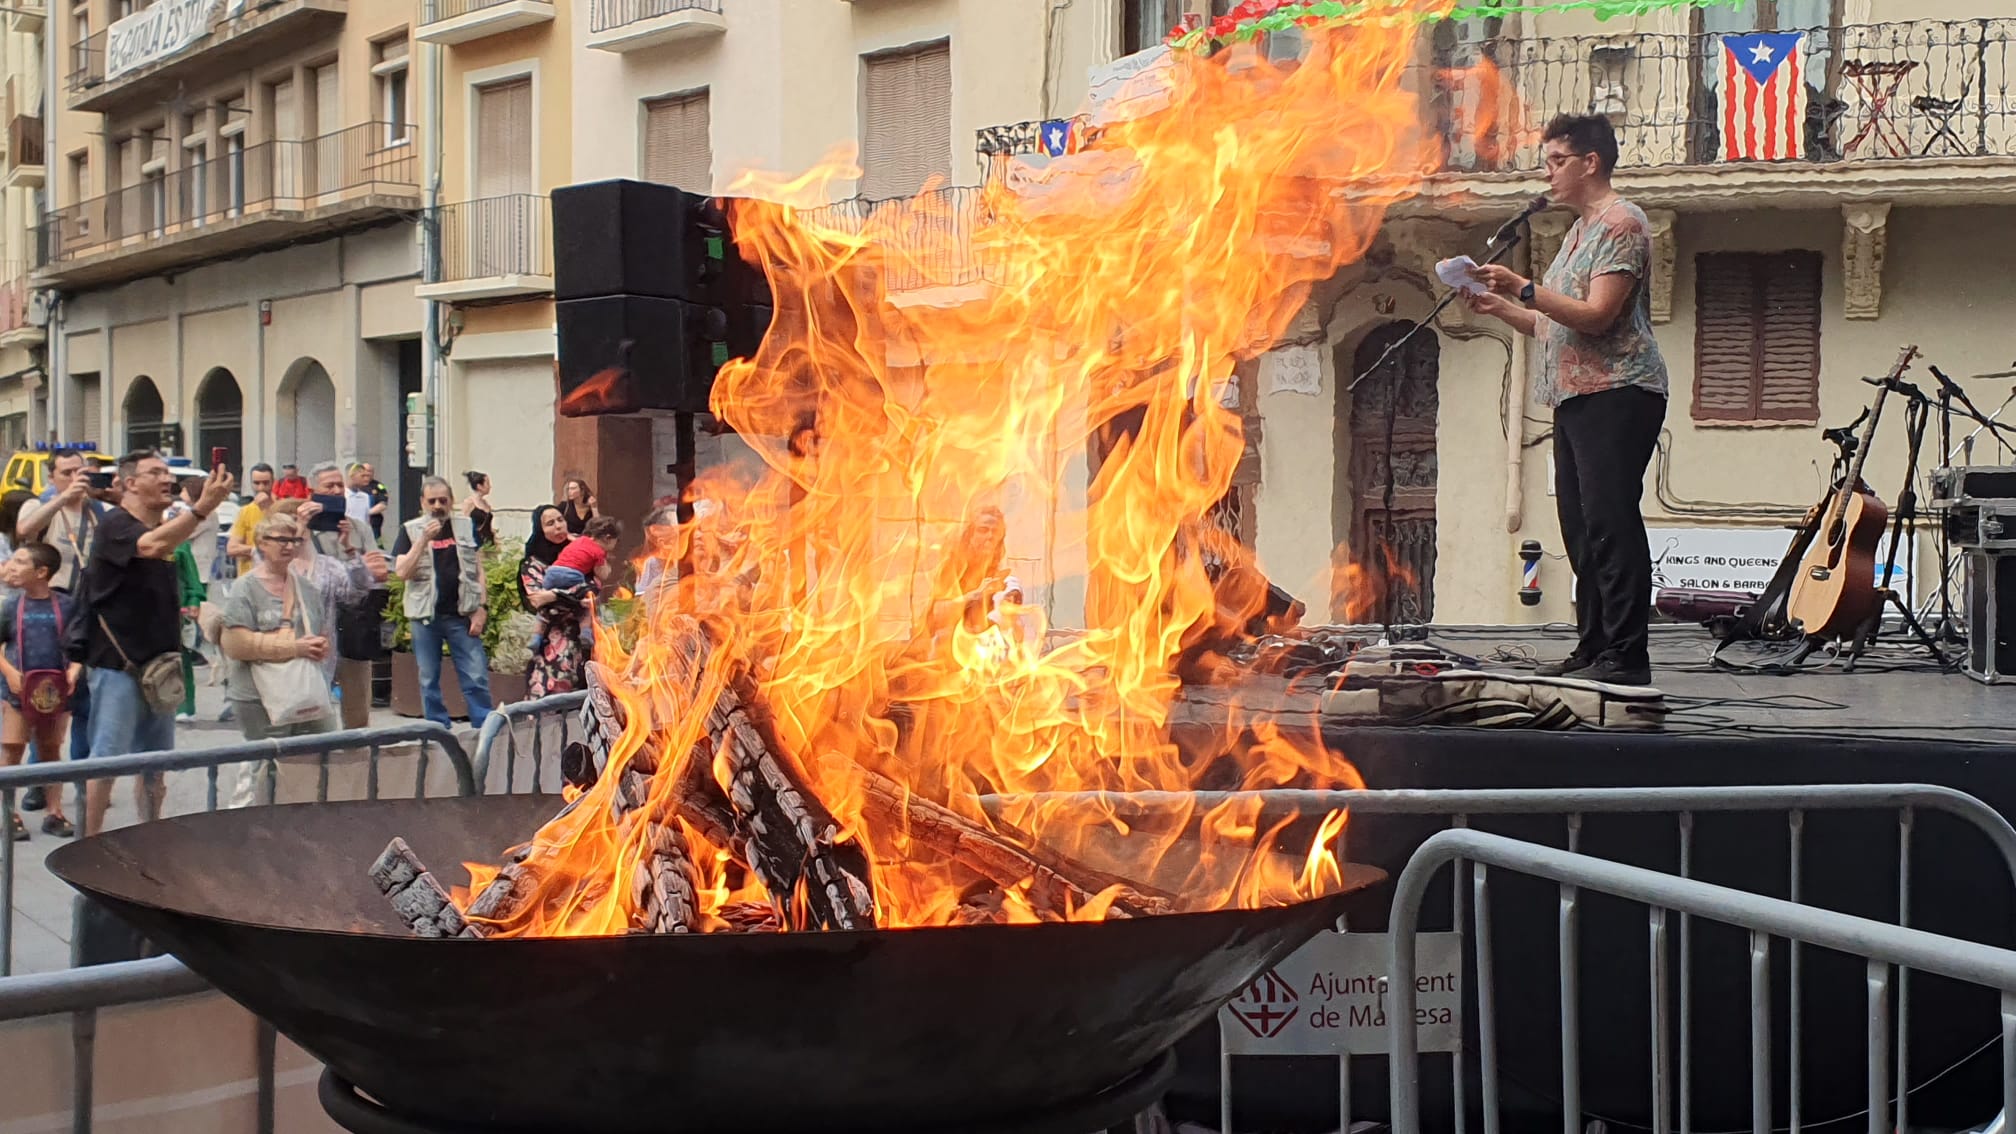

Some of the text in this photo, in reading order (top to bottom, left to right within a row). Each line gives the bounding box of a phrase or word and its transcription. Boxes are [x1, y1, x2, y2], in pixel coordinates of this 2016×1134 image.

[1665, 555, 1779, 569] KINGS AND QUEENS
[1679, 578, 1719, 589] SALON
[1722, 579, 1731, 588] &
[1309, 972, 1455, 1001] Ajuntaent
[1310, 1005, 1452, 1028] de Maesa
